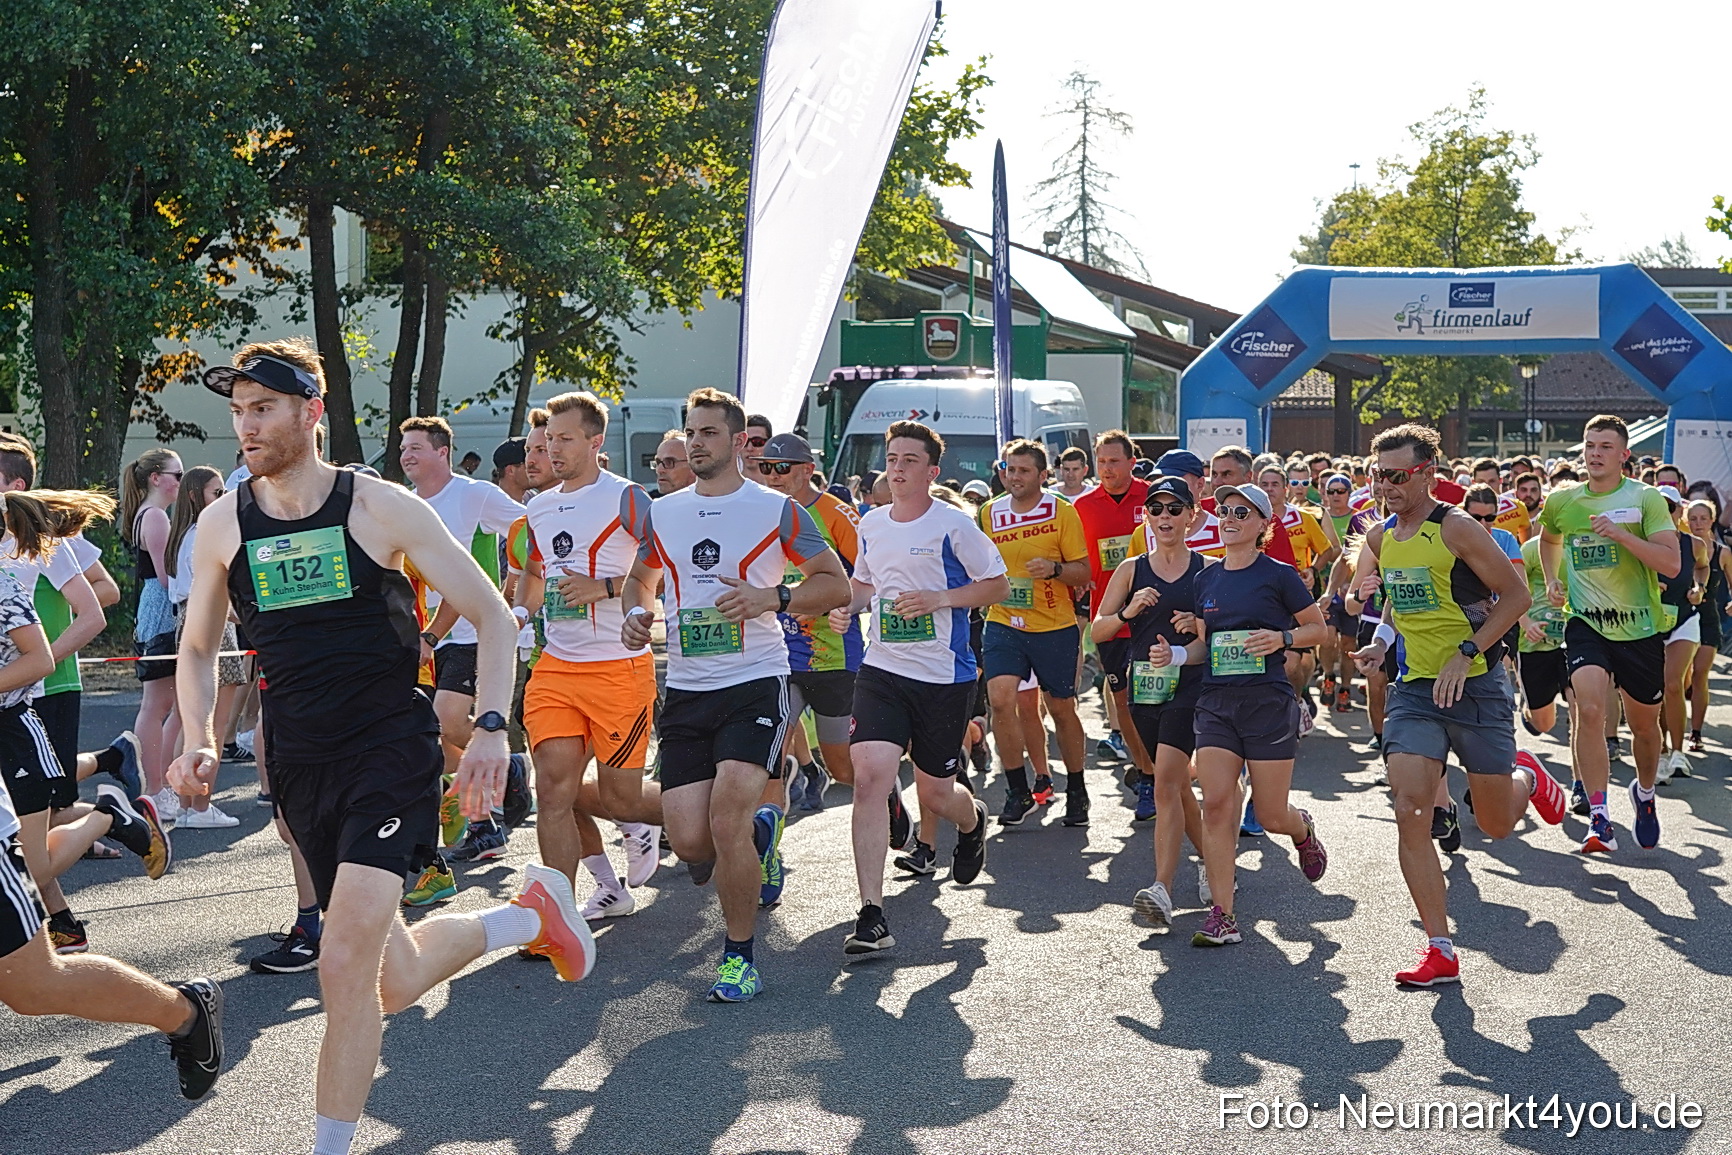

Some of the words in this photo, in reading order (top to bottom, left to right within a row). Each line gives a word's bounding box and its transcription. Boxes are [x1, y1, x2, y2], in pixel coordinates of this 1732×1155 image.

[1433, 308, 1533, 328] firmenlauf
[1240, 337, 1295, 352] Fischer
[992, 531, 1018, 544] MAX
[1022, 523, 1058, 539] BÖGL
[1581, 545, 1606, 558] 679
[276, 555, 324, 583] 152
[333, 555, 346, 589] 2022
[257, 572, 270, 597] RUN
[272, 585, 295, 596] Kuhn
[297, 580, 334, 592] Stephan
[1391, 584, 1426, 599] 1596
[549, 592, 567, 606] 37
[890, 614, 919, 630] 313
[692, 623, 725, 641] 374
[1221, 645, 1250, 661] 494
[1140, 676, 1164, 691] 480
